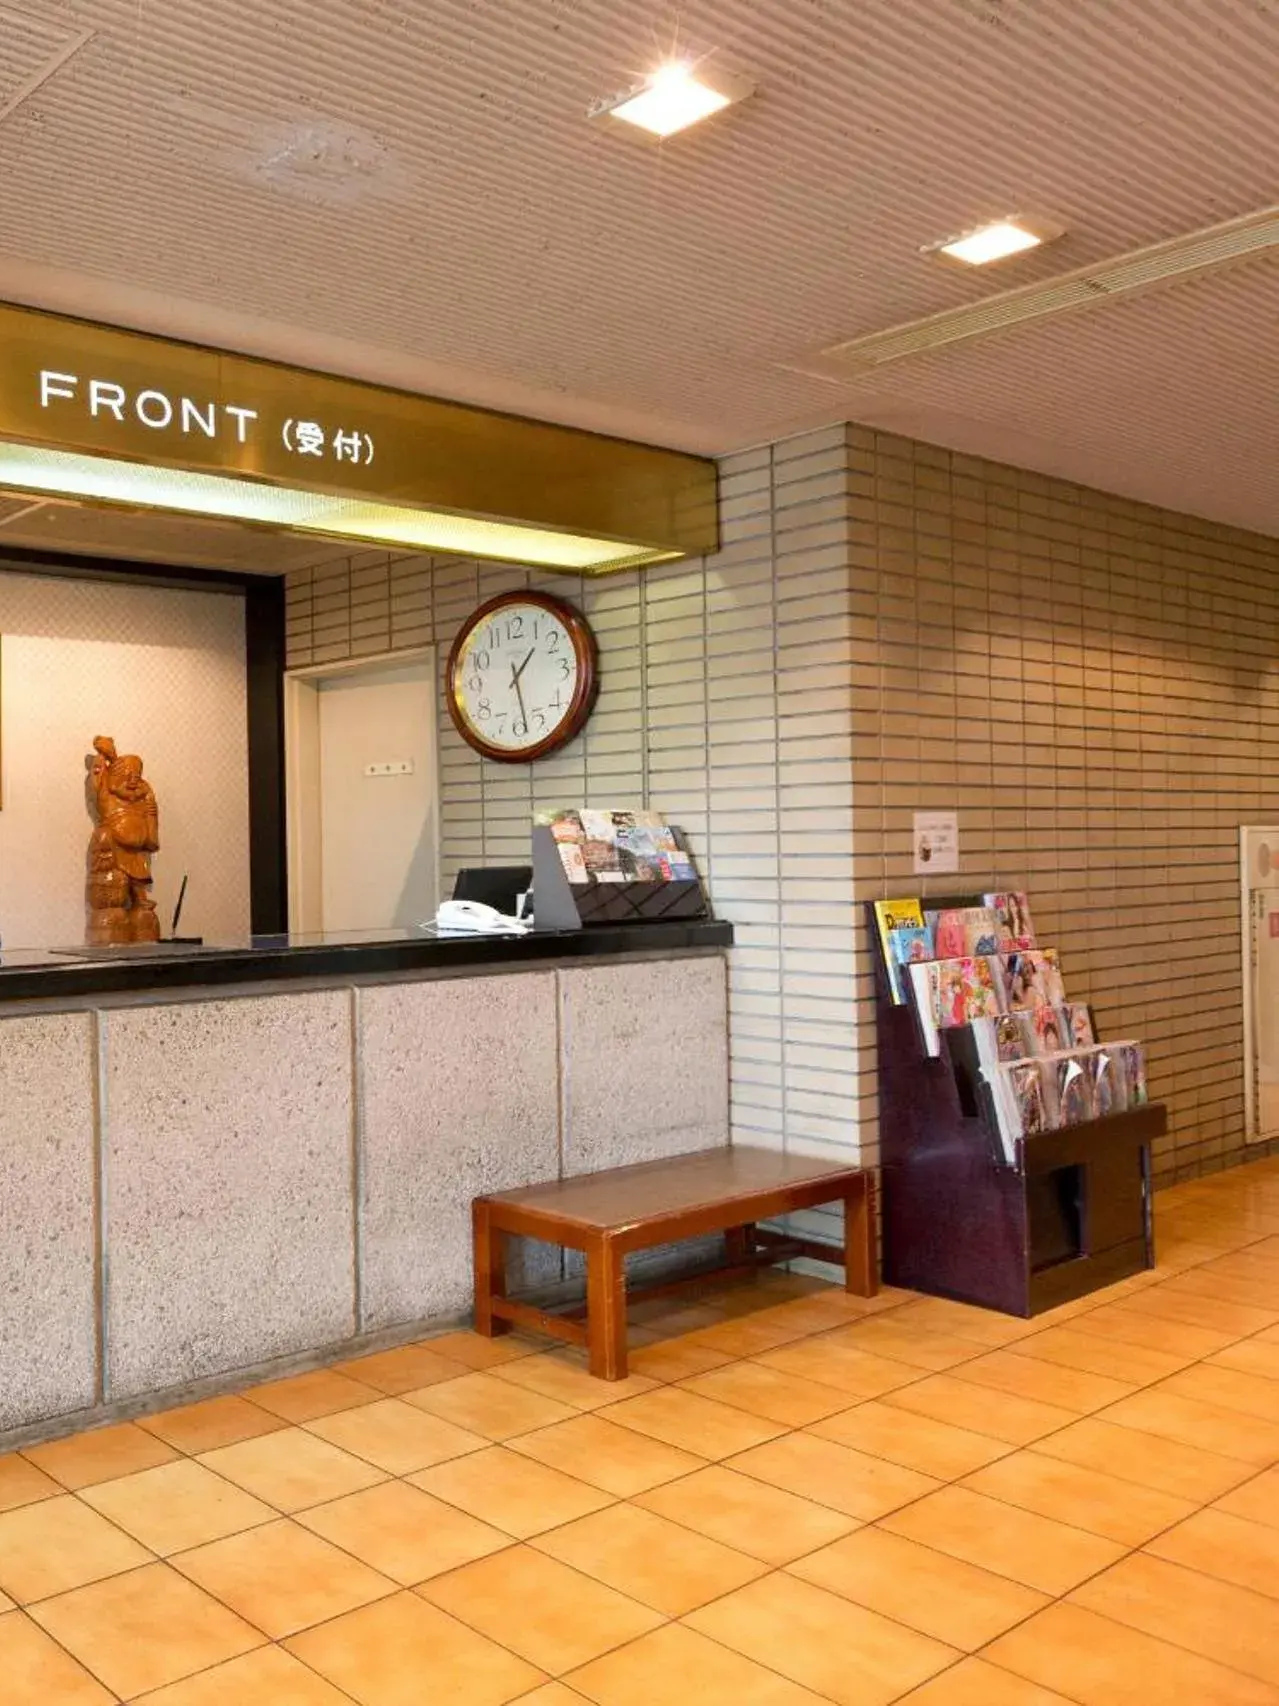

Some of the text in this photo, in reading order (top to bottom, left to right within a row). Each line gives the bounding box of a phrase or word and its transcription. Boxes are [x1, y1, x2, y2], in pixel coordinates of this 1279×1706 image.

[39, 369, 375, 466] FRONT (受付)
[488, 626, 500, 650] 11
[505, 616, 524, 640] 12
[533, 620, 538, 640] 1
[545, 630, 560, 654] 2
[472, 651, 490, 671] 10
[557, 657, 570, 681] 3
[469, 675, 483, 695] 9
[477, 697, 492, 721] 8
[495, 712, 508, 735] 7
